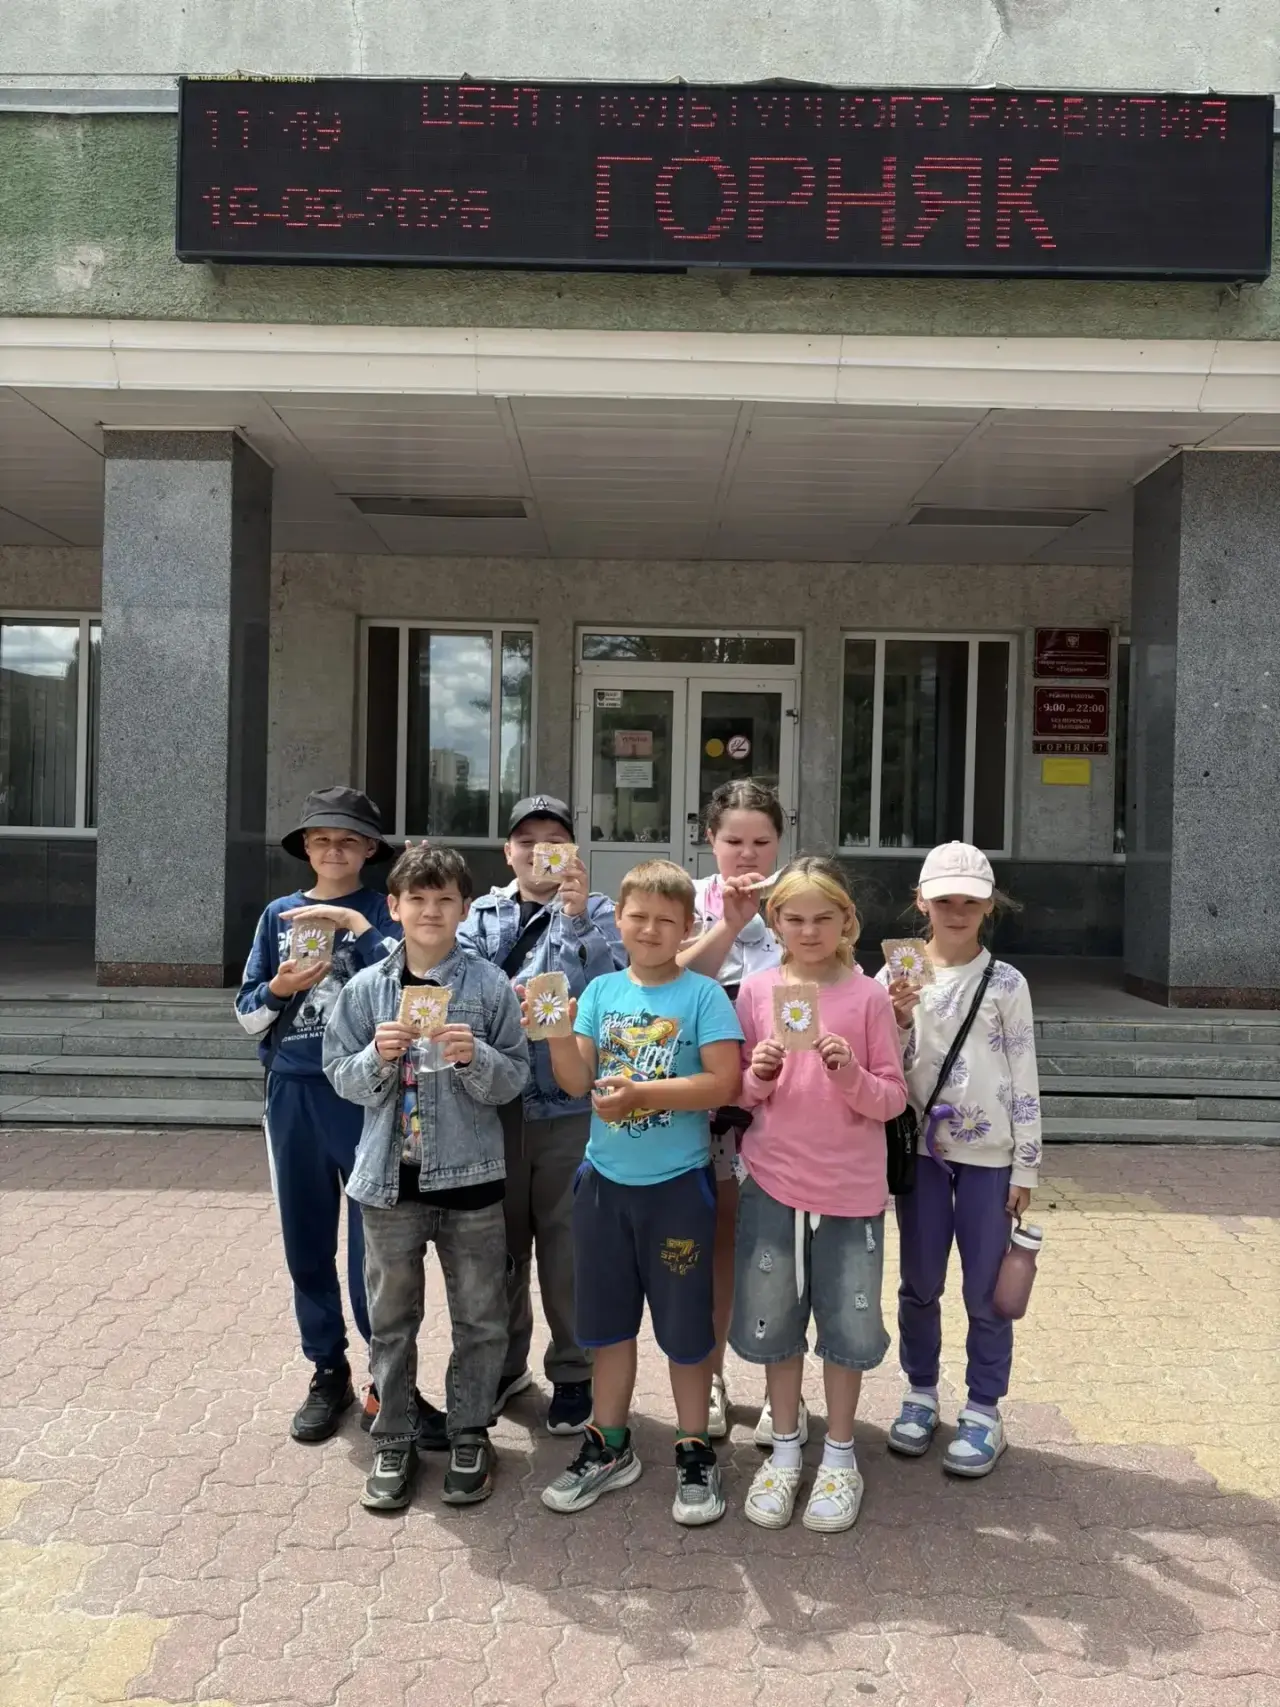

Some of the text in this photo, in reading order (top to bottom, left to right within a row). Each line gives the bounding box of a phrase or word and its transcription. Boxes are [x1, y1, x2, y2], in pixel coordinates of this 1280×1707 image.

[595, 155, 1060, 249] ГОРНЯК
[1043, 703, 1066, 712] 9:00
[1076, 704, 1105, 713] 22:00
